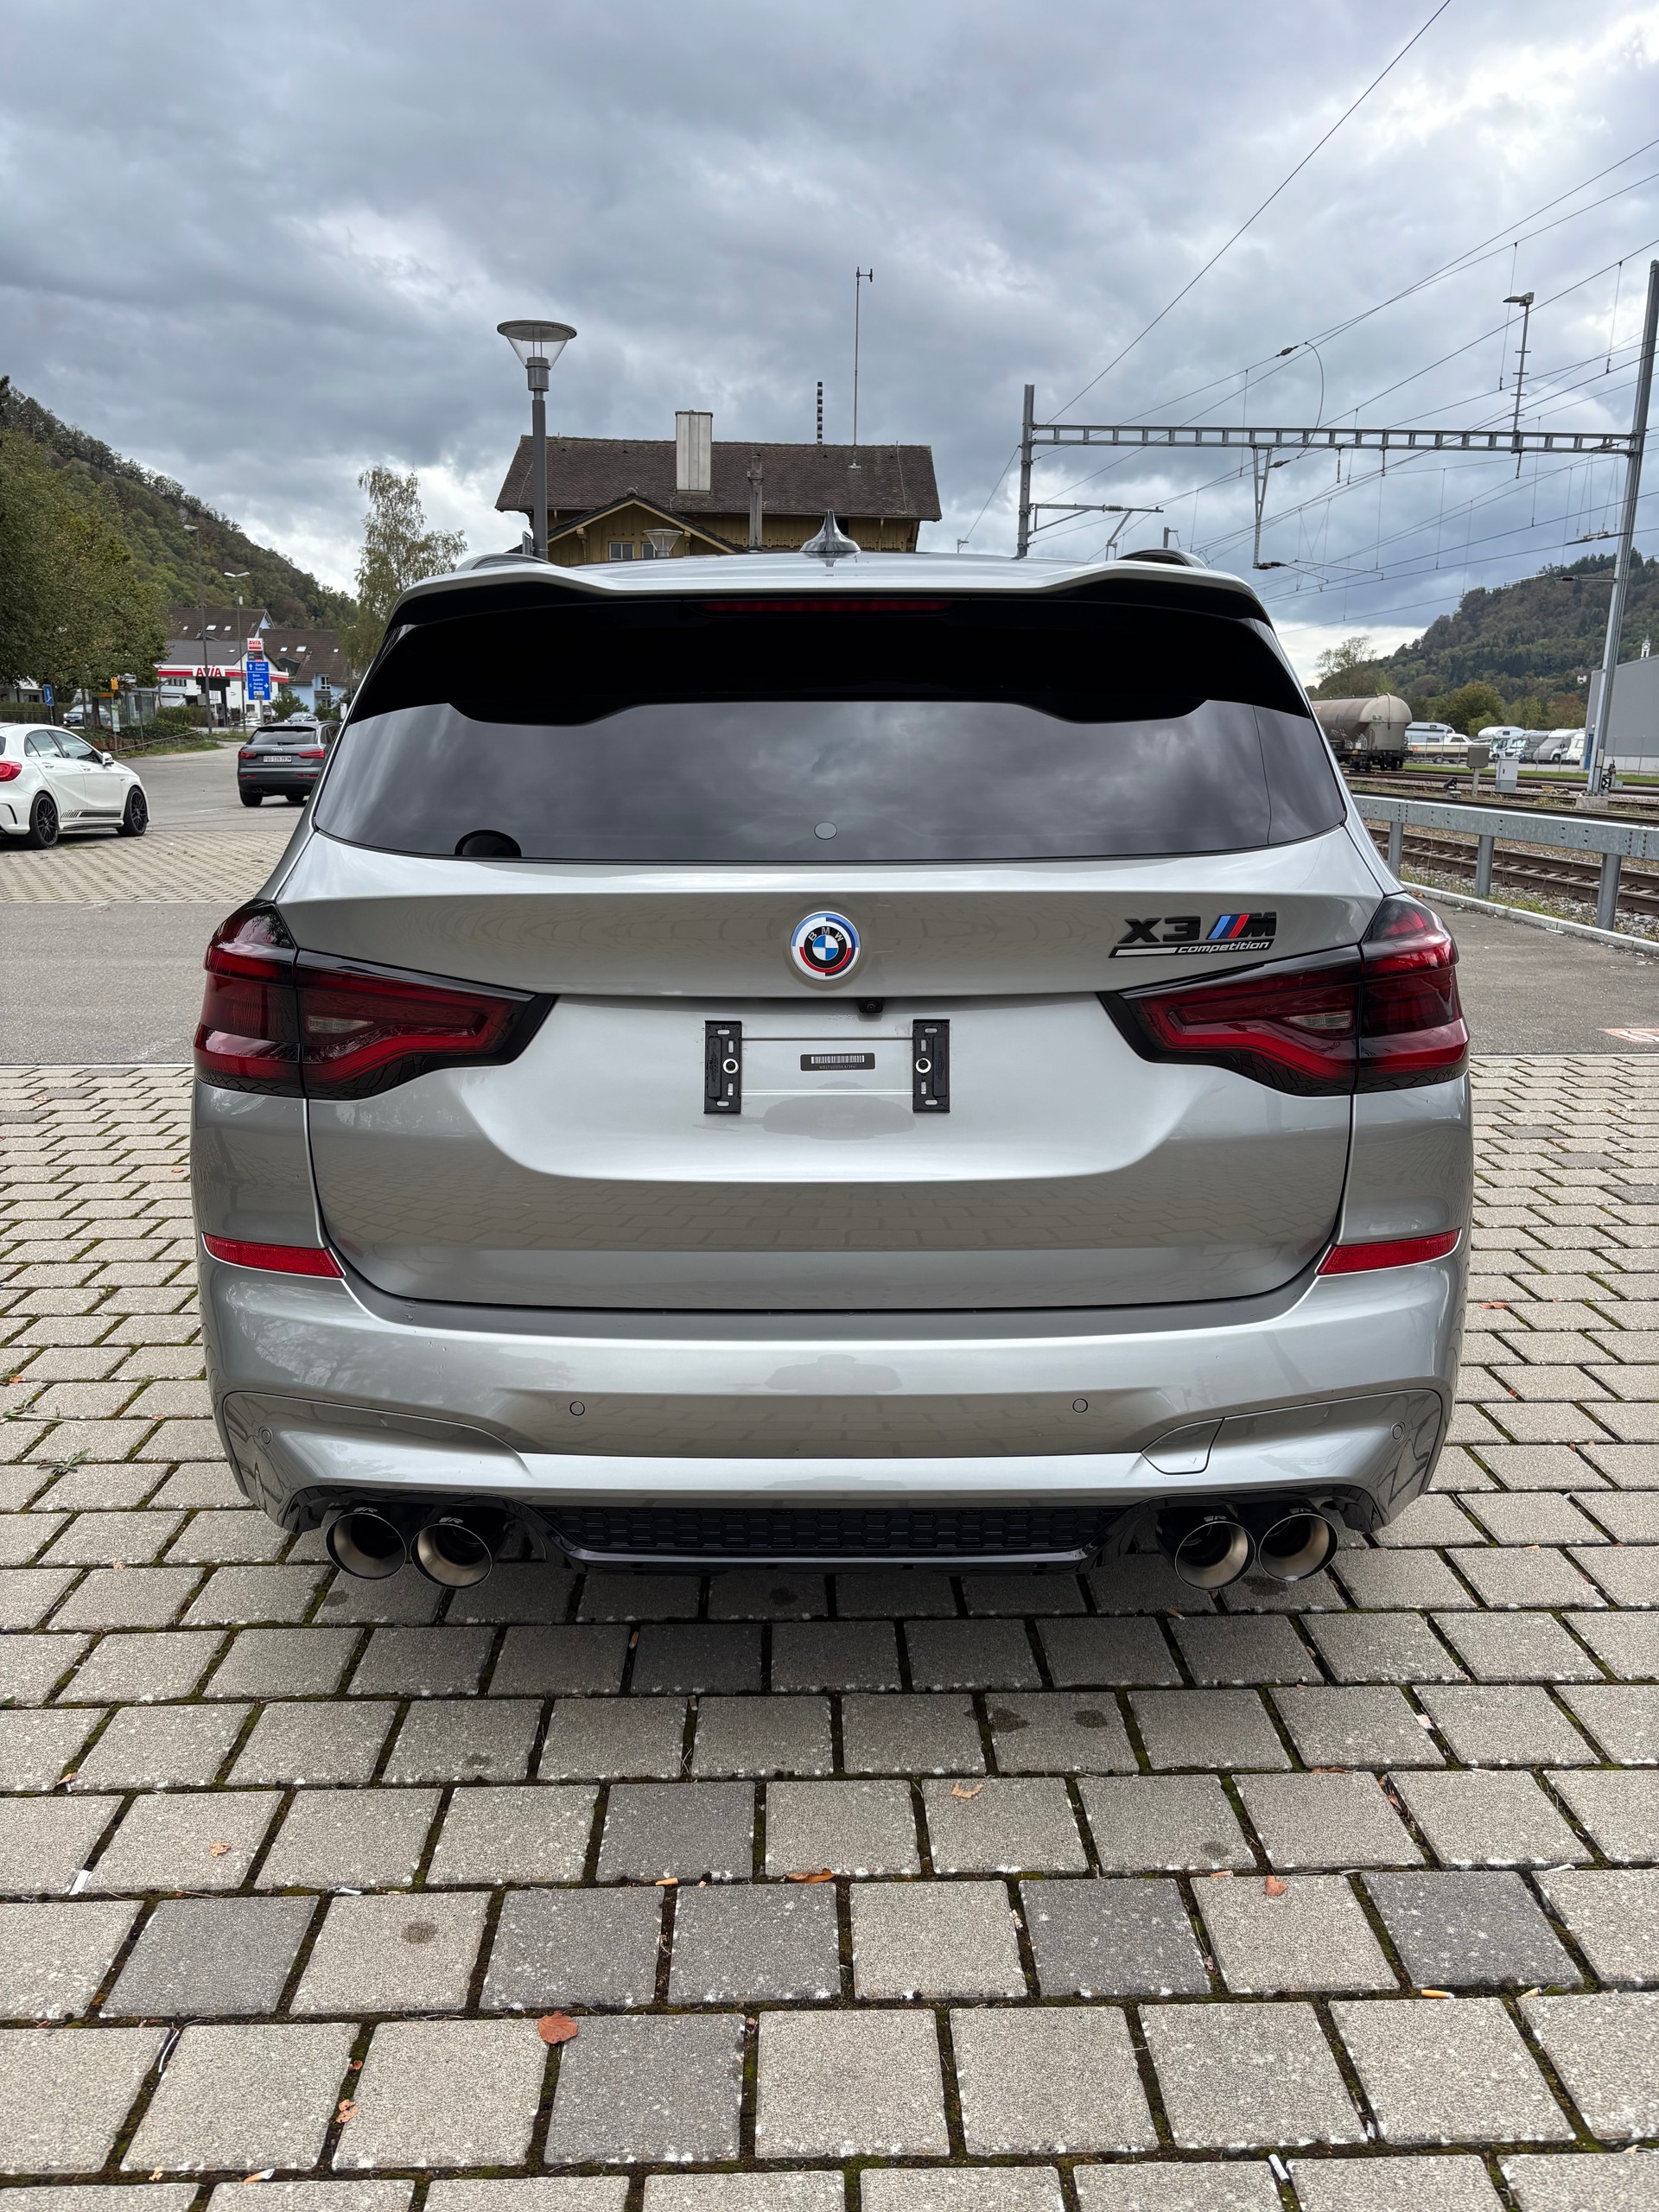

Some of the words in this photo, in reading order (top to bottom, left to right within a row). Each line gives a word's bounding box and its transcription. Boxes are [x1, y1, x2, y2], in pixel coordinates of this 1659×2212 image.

[807, 926, 844, 942] BMW
[1117, 916, 1201, 944] X3
[1177, 941, 1270, 954] competition
